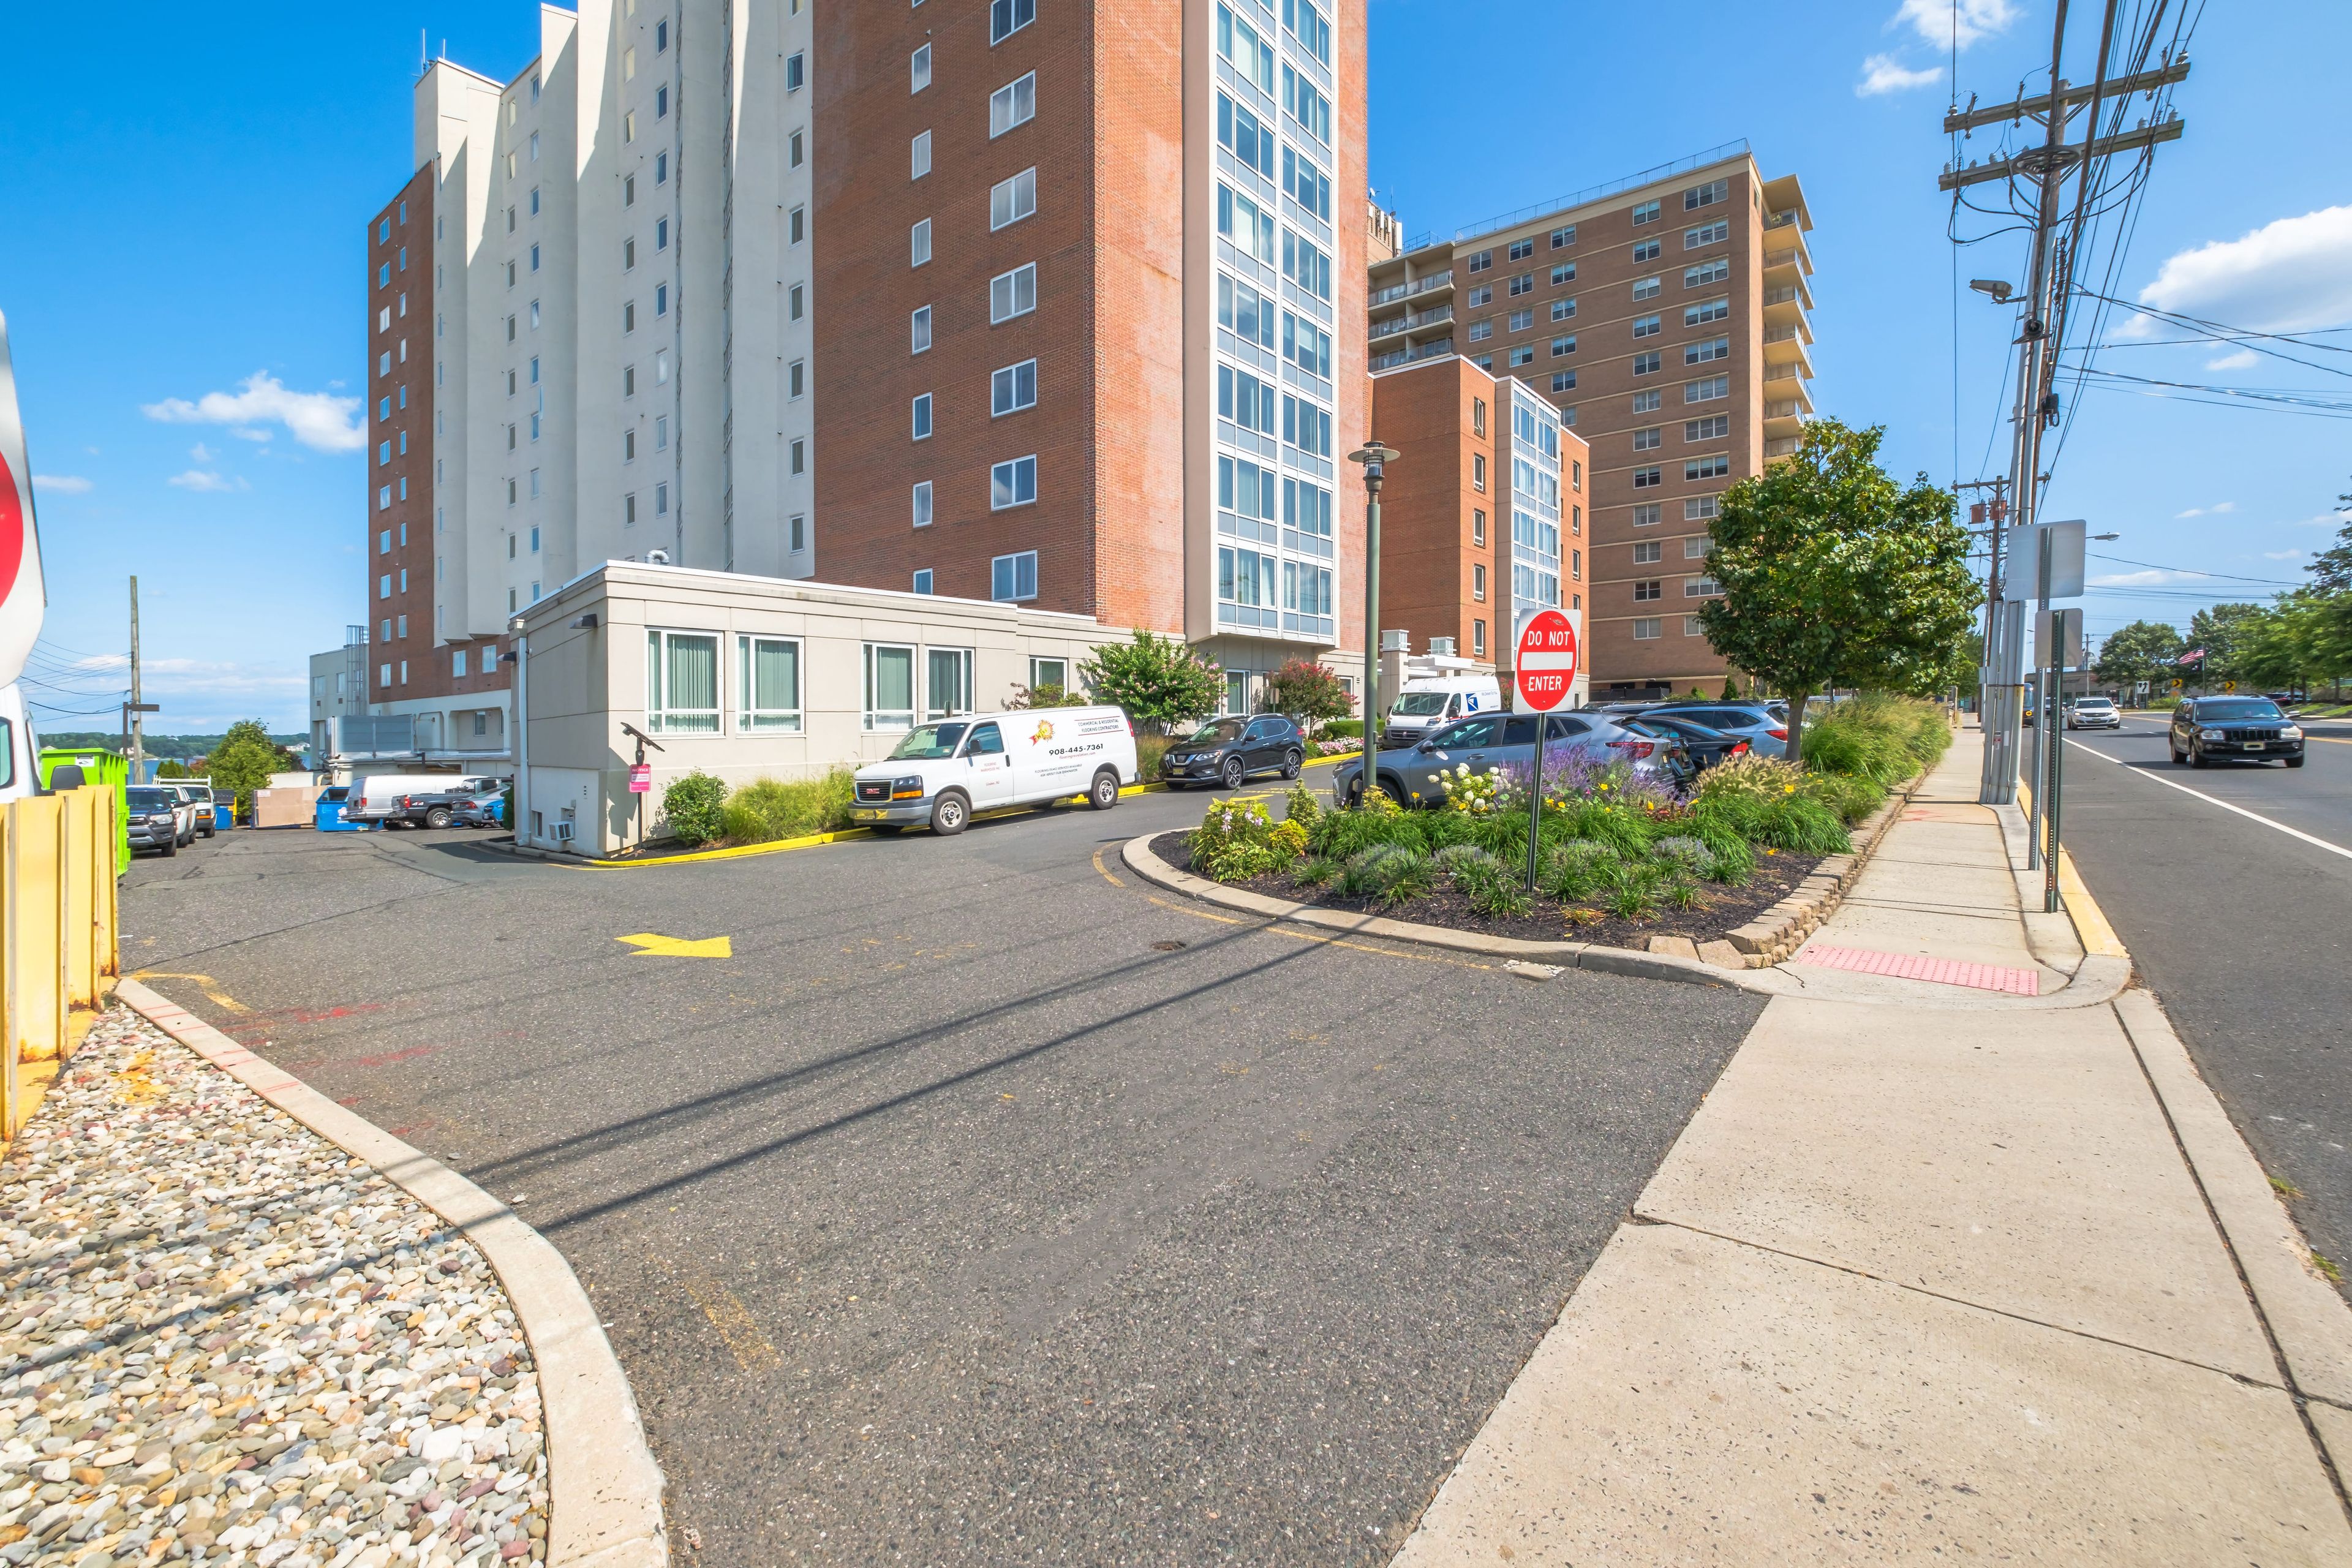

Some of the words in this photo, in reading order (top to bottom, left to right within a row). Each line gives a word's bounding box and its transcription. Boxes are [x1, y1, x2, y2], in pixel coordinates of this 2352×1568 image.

[1528, 630, 1542, 646] DO
[1548, 631, 1570, 646] NOT
[1528, 676, 1562, 692] ENTER
[1049, 743, 1103, 756] 908-445-7361
